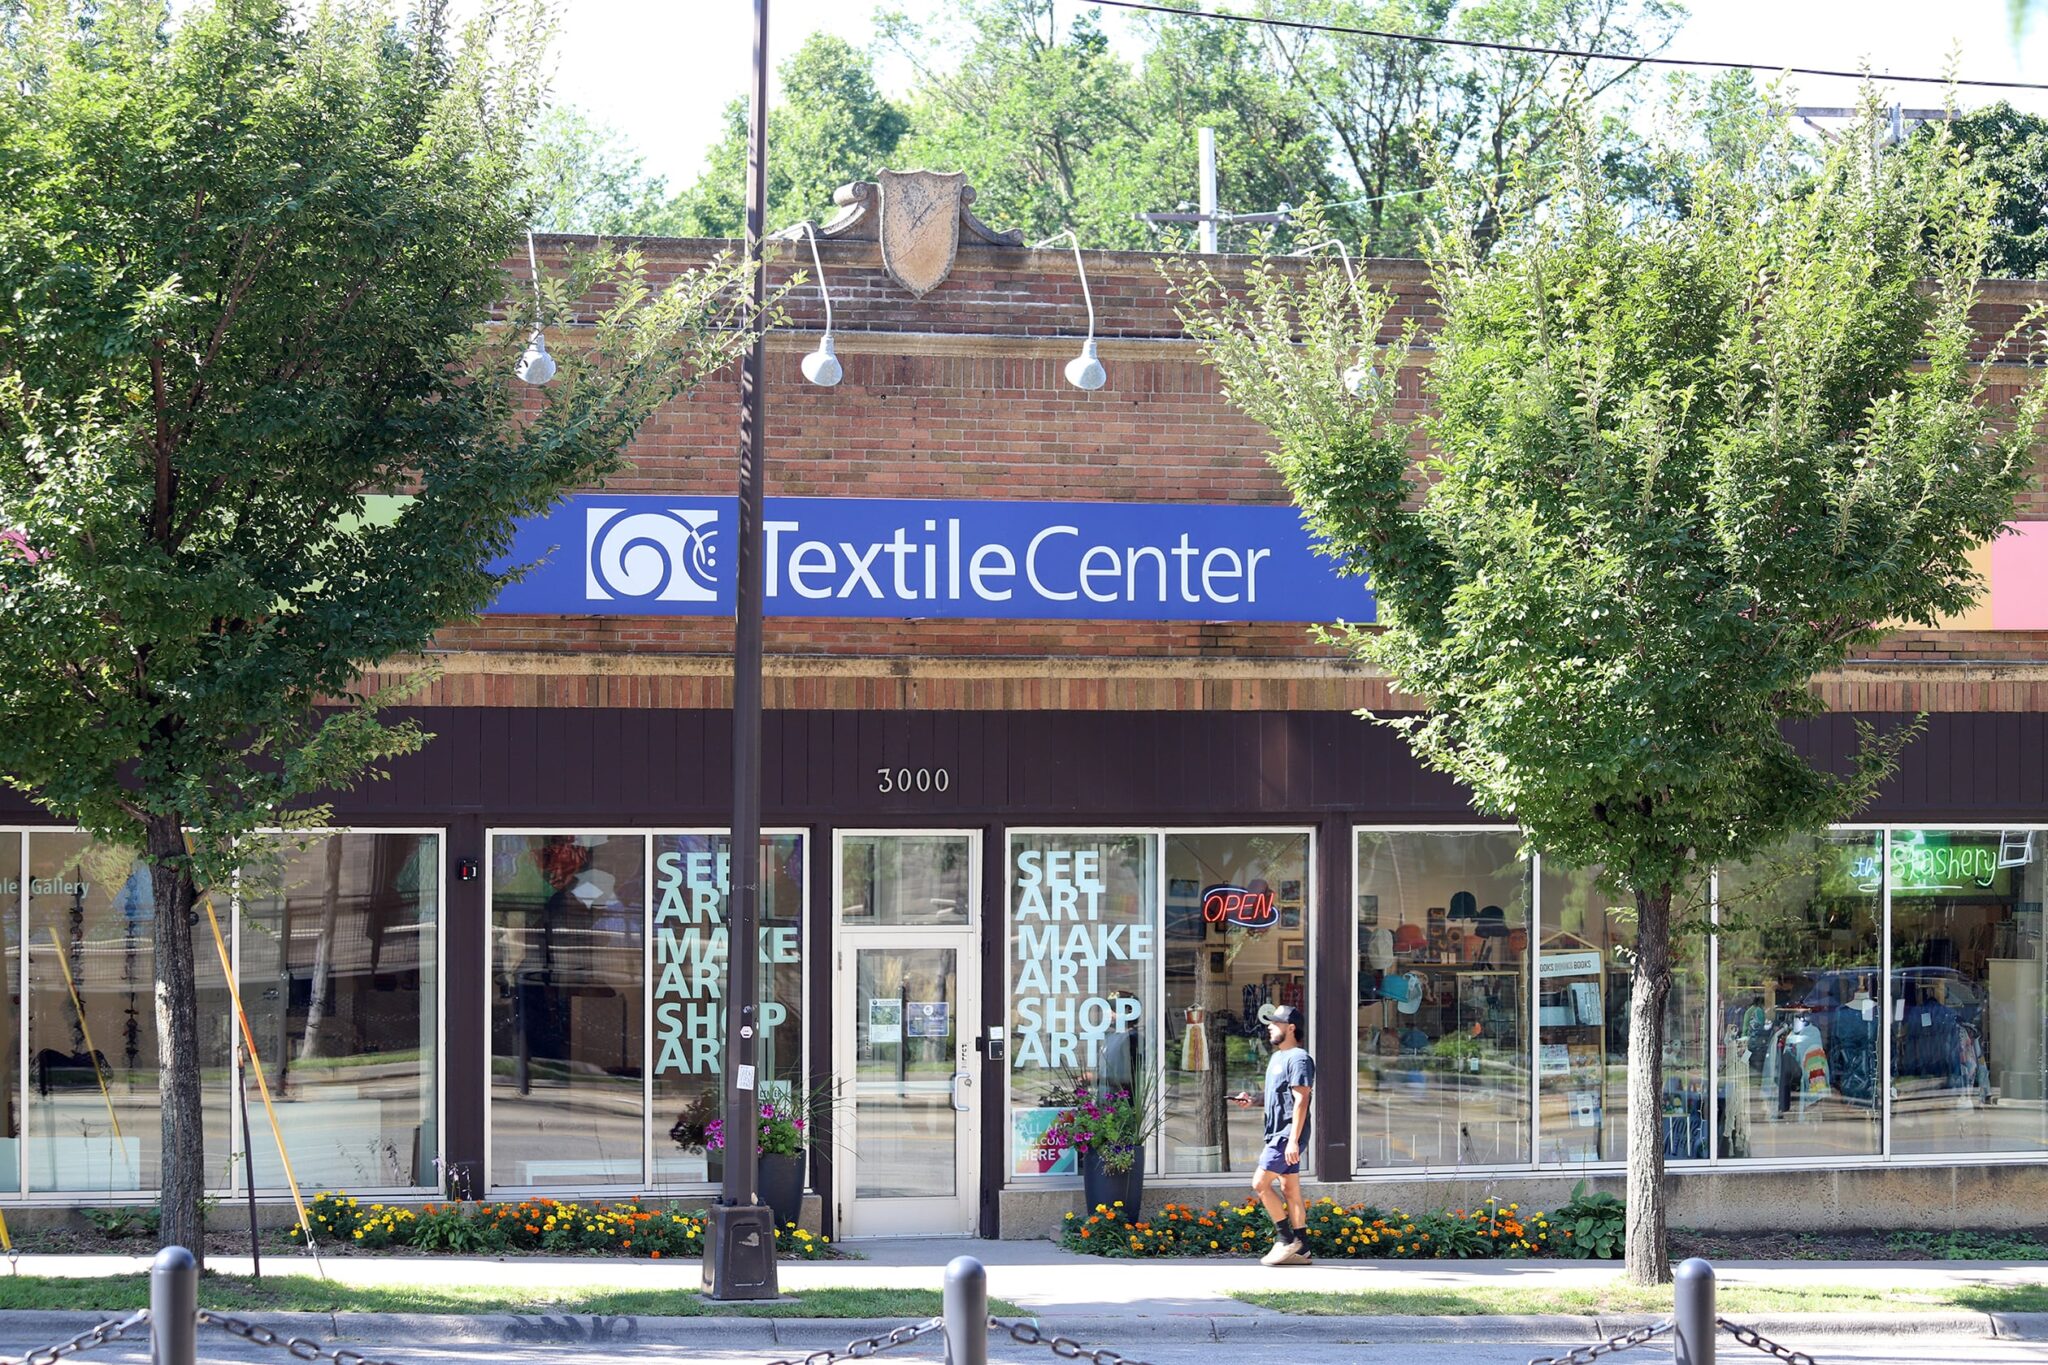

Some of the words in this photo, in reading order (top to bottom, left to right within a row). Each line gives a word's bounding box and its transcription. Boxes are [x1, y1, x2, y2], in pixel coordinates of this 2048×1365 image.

[877, 768, 949, 792] 3000
[1017, 850, 1100, 888] SEE
[1850, 856, 1881, 878] th
[0, 877, 18, 894] le
[31, 877, 90, 898] Gallery
[654, 887, 730, 924] AR
[1015, 885, 1106, 921] ART
[1204, 892, 1275, 922] OPEN
[1018, 924, 1154, 960] MAKE
[654, 962, 729, 999] AR
[1014, 958, 1106, 994] ART
[1573, 960, 1592, 970] BOOKS
[656, 1002, 787, 1040] SHP
[1017, 997, 1142, 1034] SHOP
[654, 1037, 727, 1074] AR
[1014, 1031, 1105, 1067] ART
[1019, 1122, 1042, 1134] ALL
[1020, 1136, 1068, 1146] WELCOM
[1020, 1148, 1056, 1161] HERE
